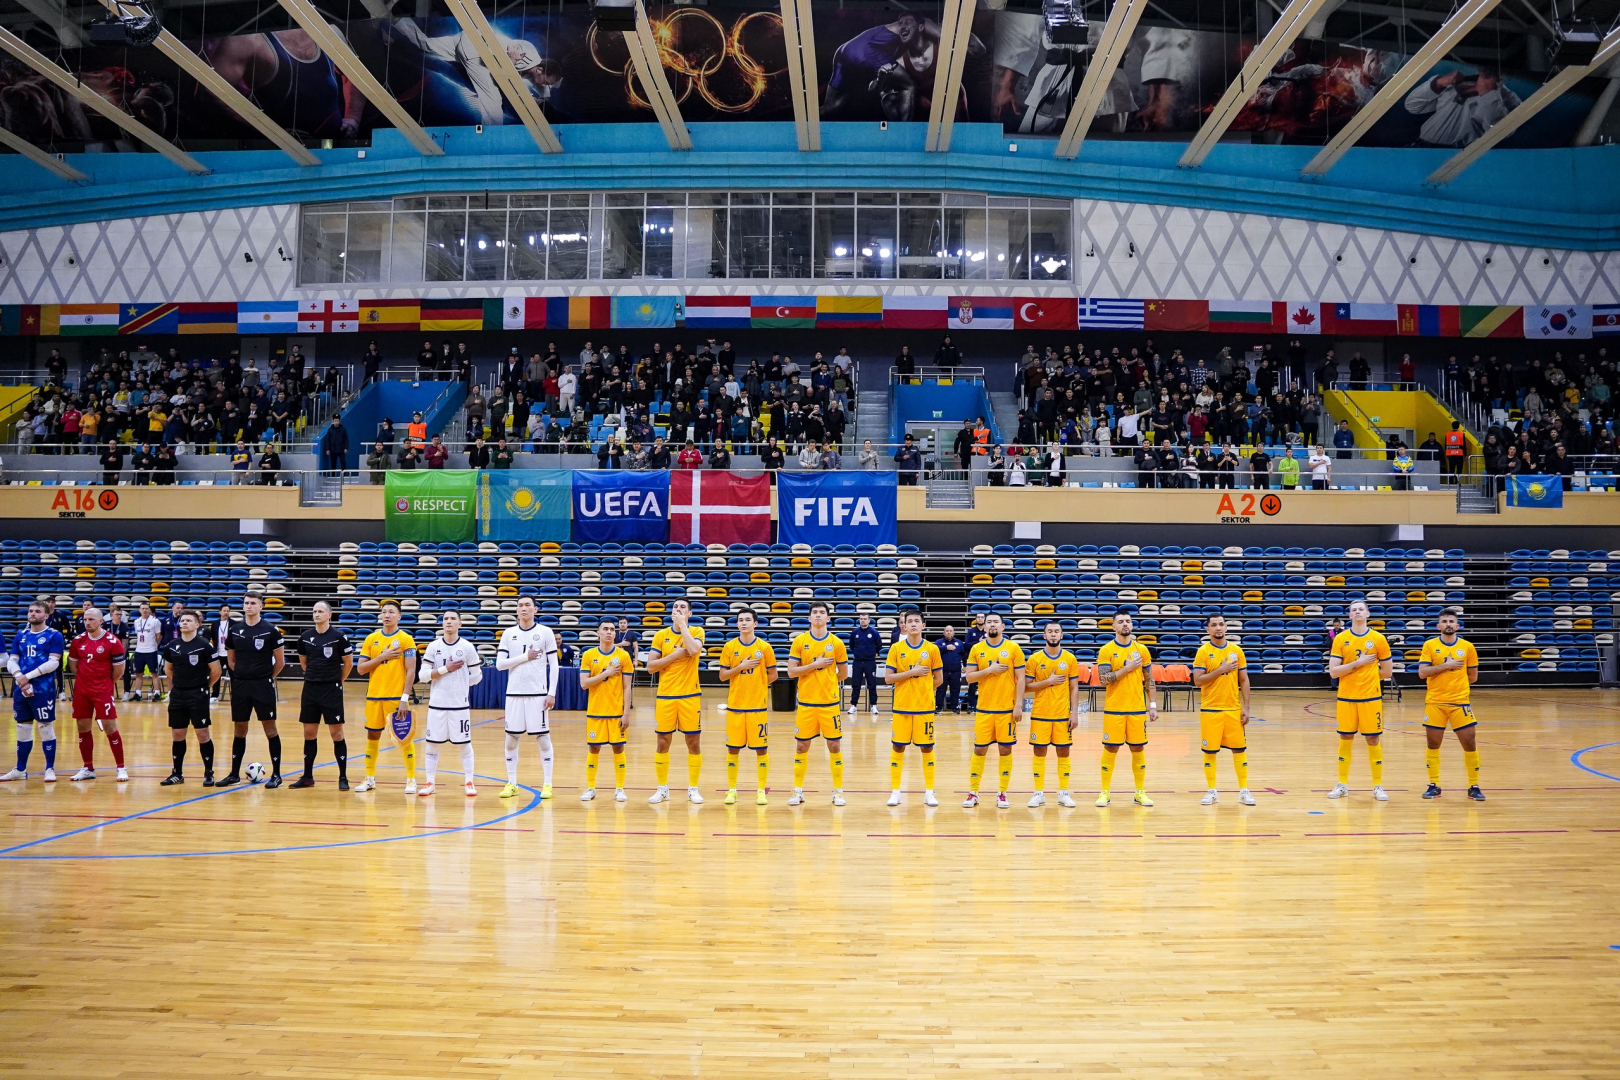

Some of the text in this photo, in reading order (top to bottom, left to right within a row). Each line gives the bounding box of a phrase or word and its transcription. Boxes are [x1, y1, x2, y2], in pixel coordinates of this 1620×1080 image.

[51, 489, 95, 511] A 16
[413, 499, 467, 511] RESPECT
[580, 491, 662, 517] UEFA
[1216, 493, 1256, 515] A 2
[794, 497, 879, 526] FIFA
[27, 645, 36, 657] 16
[87, 653, 93, 663] 7
[37, 707, 48, 719] 16
[105, 703, 111, 715] 7
[541, 710, 546, 723] 1
[459, 719, 469, 733] 16
[757, 723, 768, 738] 20
[924, 721, 934, 735] 15
